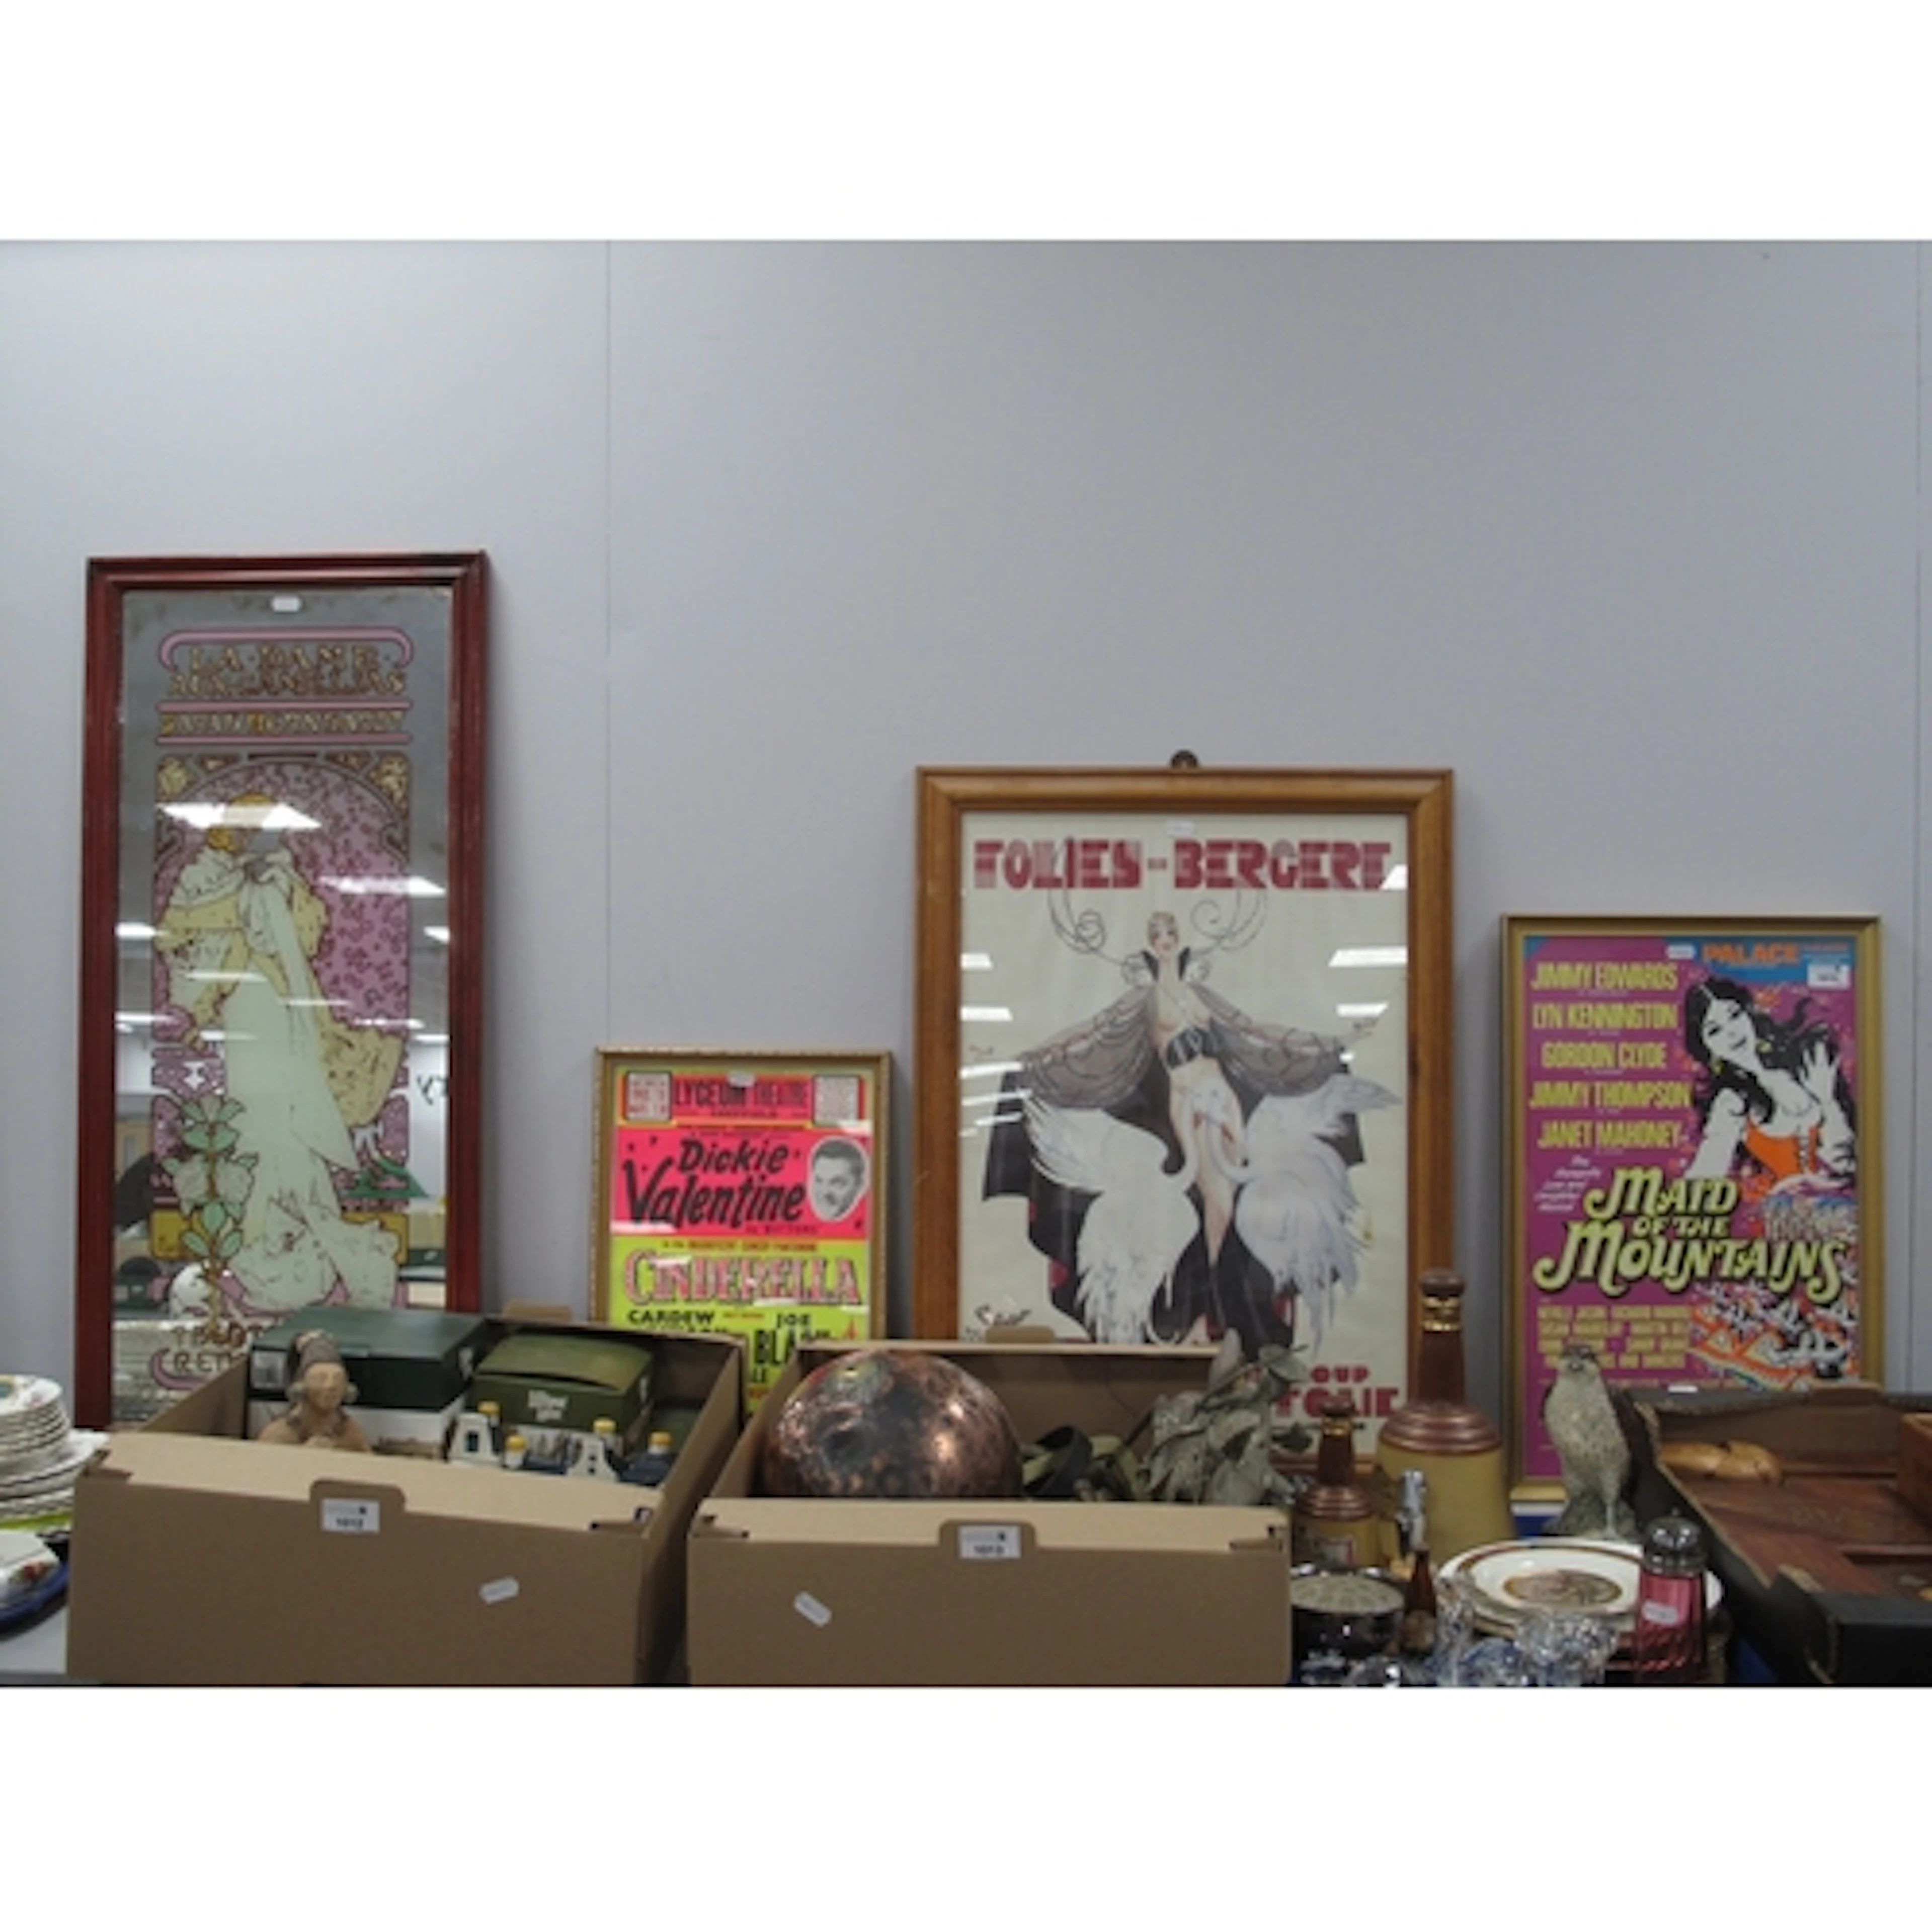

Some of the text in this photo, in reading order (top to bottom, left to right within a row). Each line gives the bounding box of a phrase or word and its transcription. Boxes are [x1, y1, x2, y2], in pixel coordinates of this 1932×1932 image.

[974, 837, 1142, 889] FOLIES
[1174, 839, 1392, 890] BERGERE
[1702, 943, 1801, 963] PALACE
[1531, 962, 1678, 990] JIMMY EDWARDS
[1532, 1004, 1678, 1029] LYN KENNINGTON
[1619, 1042, 1668, 1069] CLYDE
[1530, 1082, 1694, 1108] JIMMY THOMPSON
[1538, 1120, 1683, 1149] JANET MAHONEY
[680, 1137, 790, 1176] Dickie
[621, 1160, 805, 1229] Valentine
[1583, 1166, 1738, 1220] MAID
[1632, 1216, 1730, 1238] OF THE
[1533, 1220, 1849, 1304] MOUNTAINS
[625, 1250, 862, 1305] CINDERELLA
[627, 1309, 715, 1325] CARDEW
[777, 1314, 811, 1327] JOE
[1311, 1364, 1370, 1383] OUP
